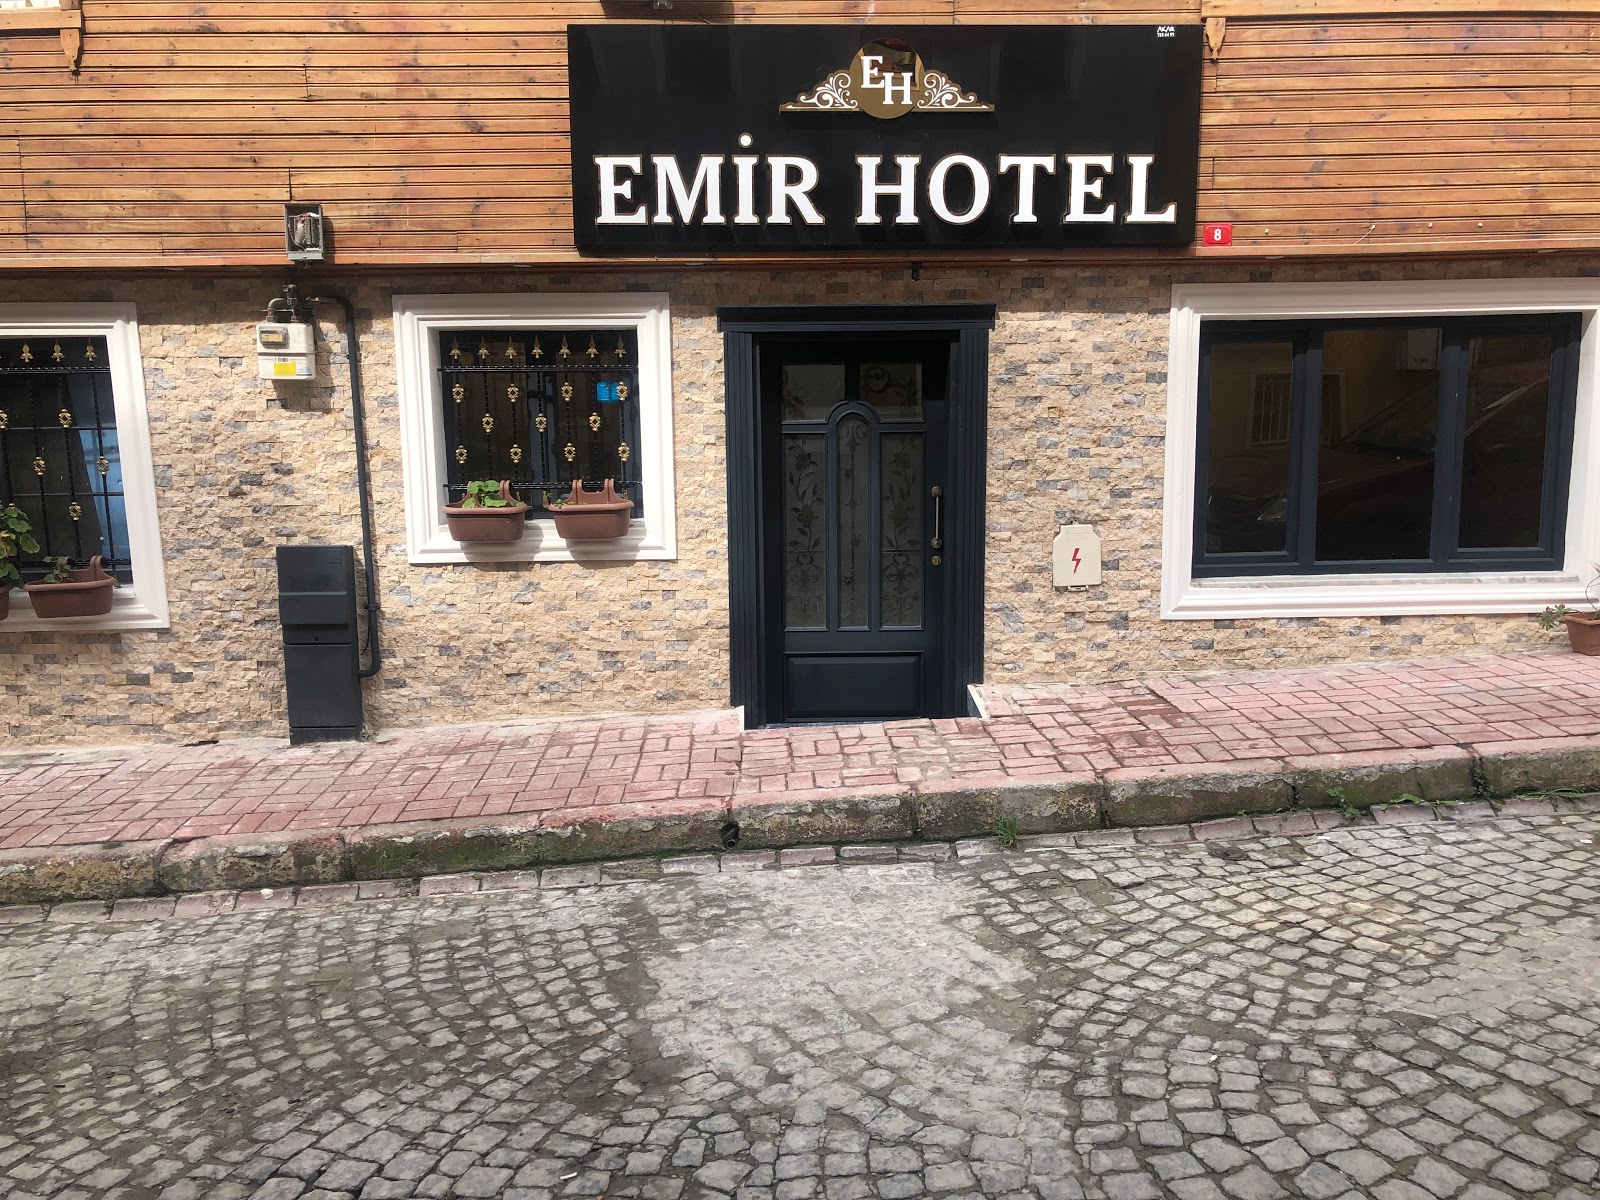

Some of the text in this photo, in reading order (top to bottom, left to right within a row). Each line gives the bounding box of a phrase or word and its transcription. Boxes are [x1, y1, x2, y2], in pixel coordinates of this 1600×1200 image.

[593, 133, 1177, 226] EMİR HOTEL
[1213, 228, 1222, 241] 8
